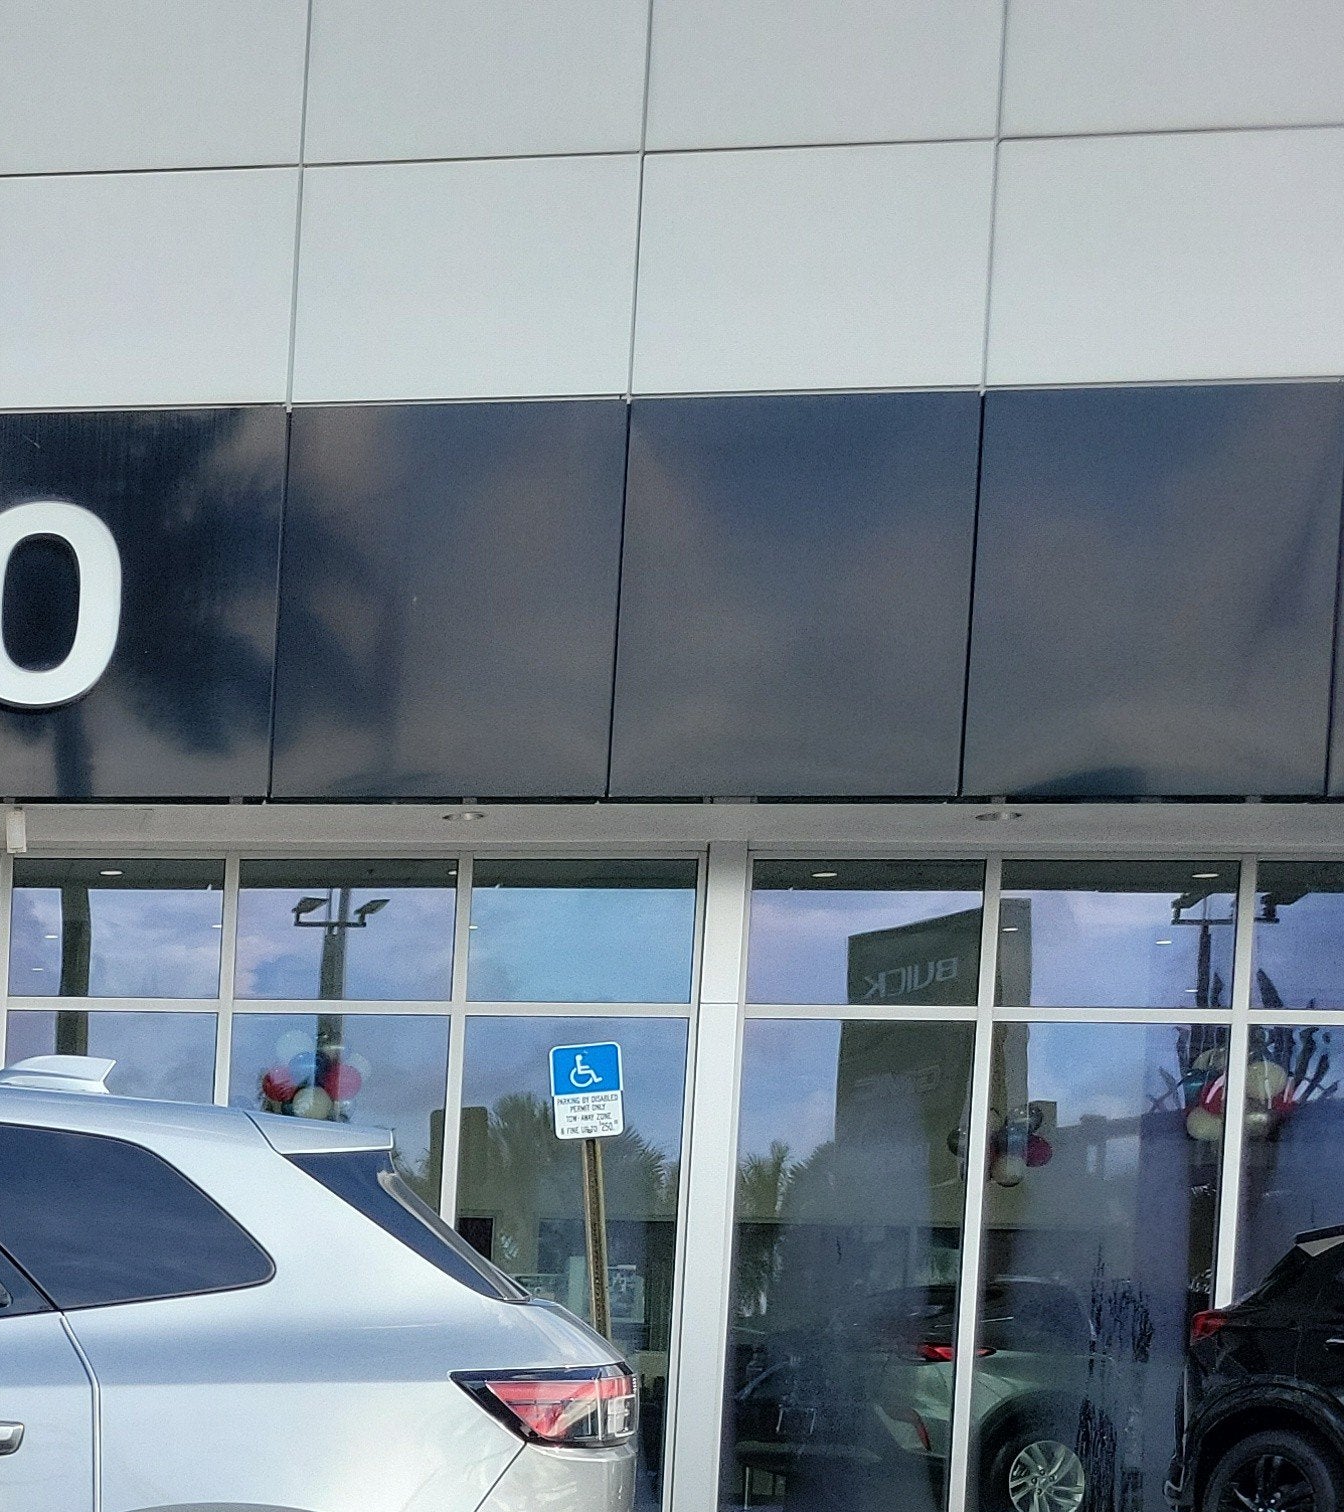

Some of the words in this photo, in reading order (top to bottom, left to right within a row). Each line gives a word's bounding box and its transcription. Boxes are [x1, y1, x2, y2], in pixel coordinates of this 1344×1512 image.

[557, 1097, 580, 1105] PARKING
[591, 1094, 618, 1103] DISABLED
[570, 1104, 590, 1112] PERMIT
[592, 1103, 606, 1111] ONLY
[597, 1112, 612, 1120] ZONE
